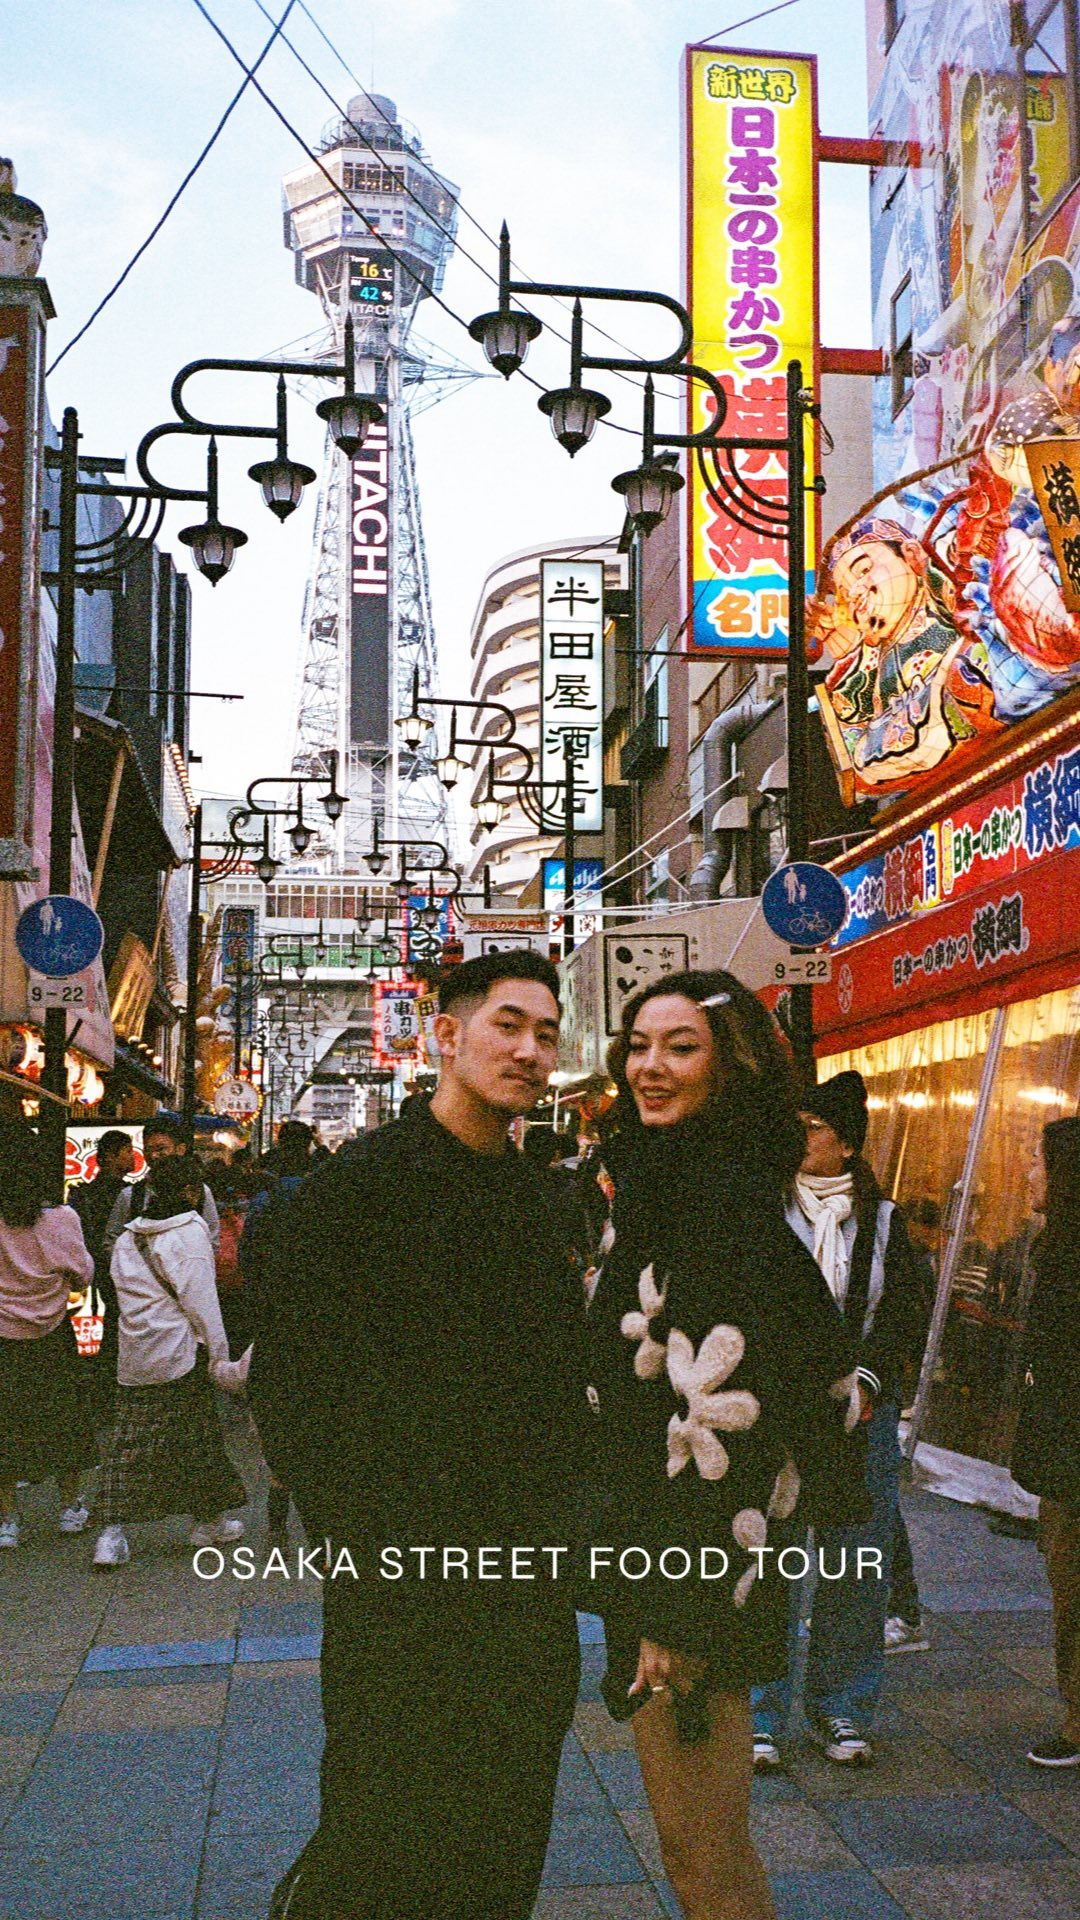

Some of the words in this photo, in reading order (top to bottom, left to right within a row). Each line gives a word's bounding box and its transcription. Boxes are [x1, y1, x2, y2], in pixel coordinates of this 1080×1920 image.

[708, 65, 796, 103] 新世界
[727, 106, 781, 370] 日本一の串かつ
[360, 264, 379, 278] 16
[360, 286, 379, 301] 42
[545, 576, 600, 814] 半田屋酒店
[952, 807, 1022, 876] 日本一の串かつ
[893, 935, 969, 988] 日本一の串かつ
